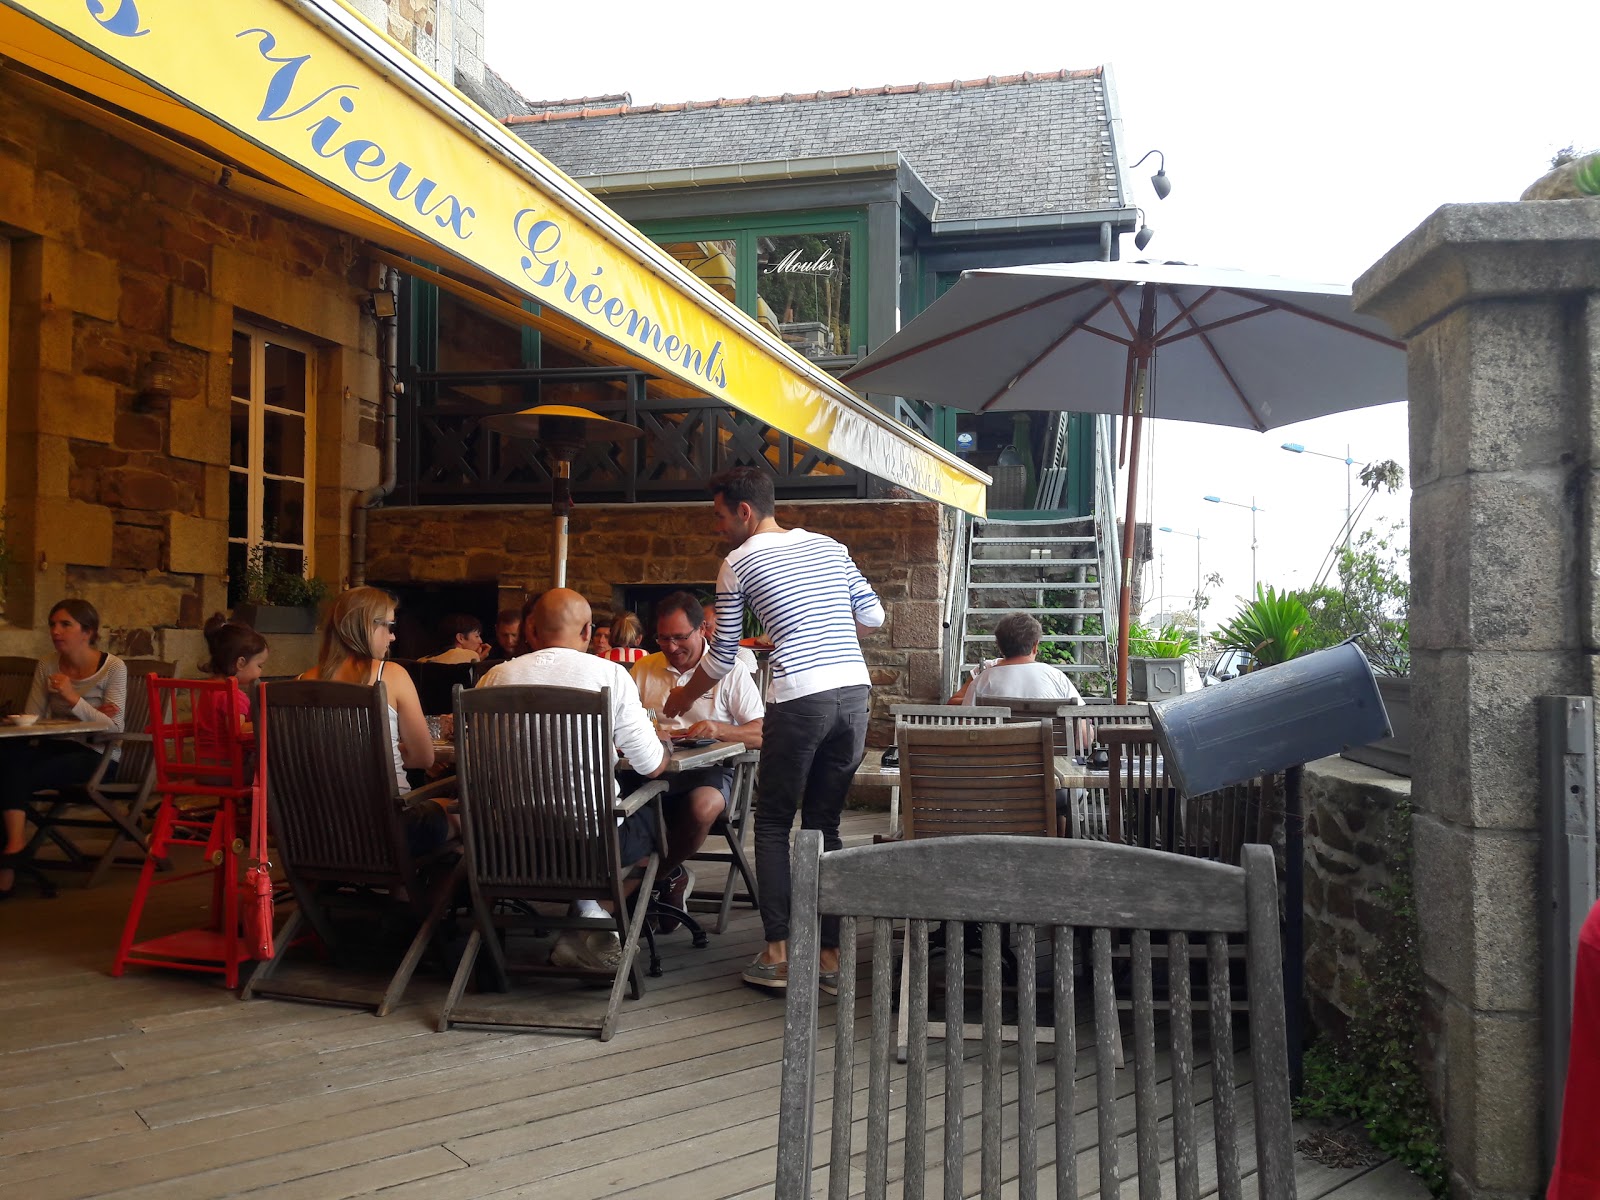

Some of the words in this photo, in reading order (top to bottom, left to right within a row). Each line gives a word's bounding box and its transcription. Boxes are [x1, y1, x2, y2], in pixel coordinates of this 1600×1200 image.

[236, 28, 476, 239] Vieux
[513, 208, 727, 389] Gréements
[763, 247, 835, 274] Moules
